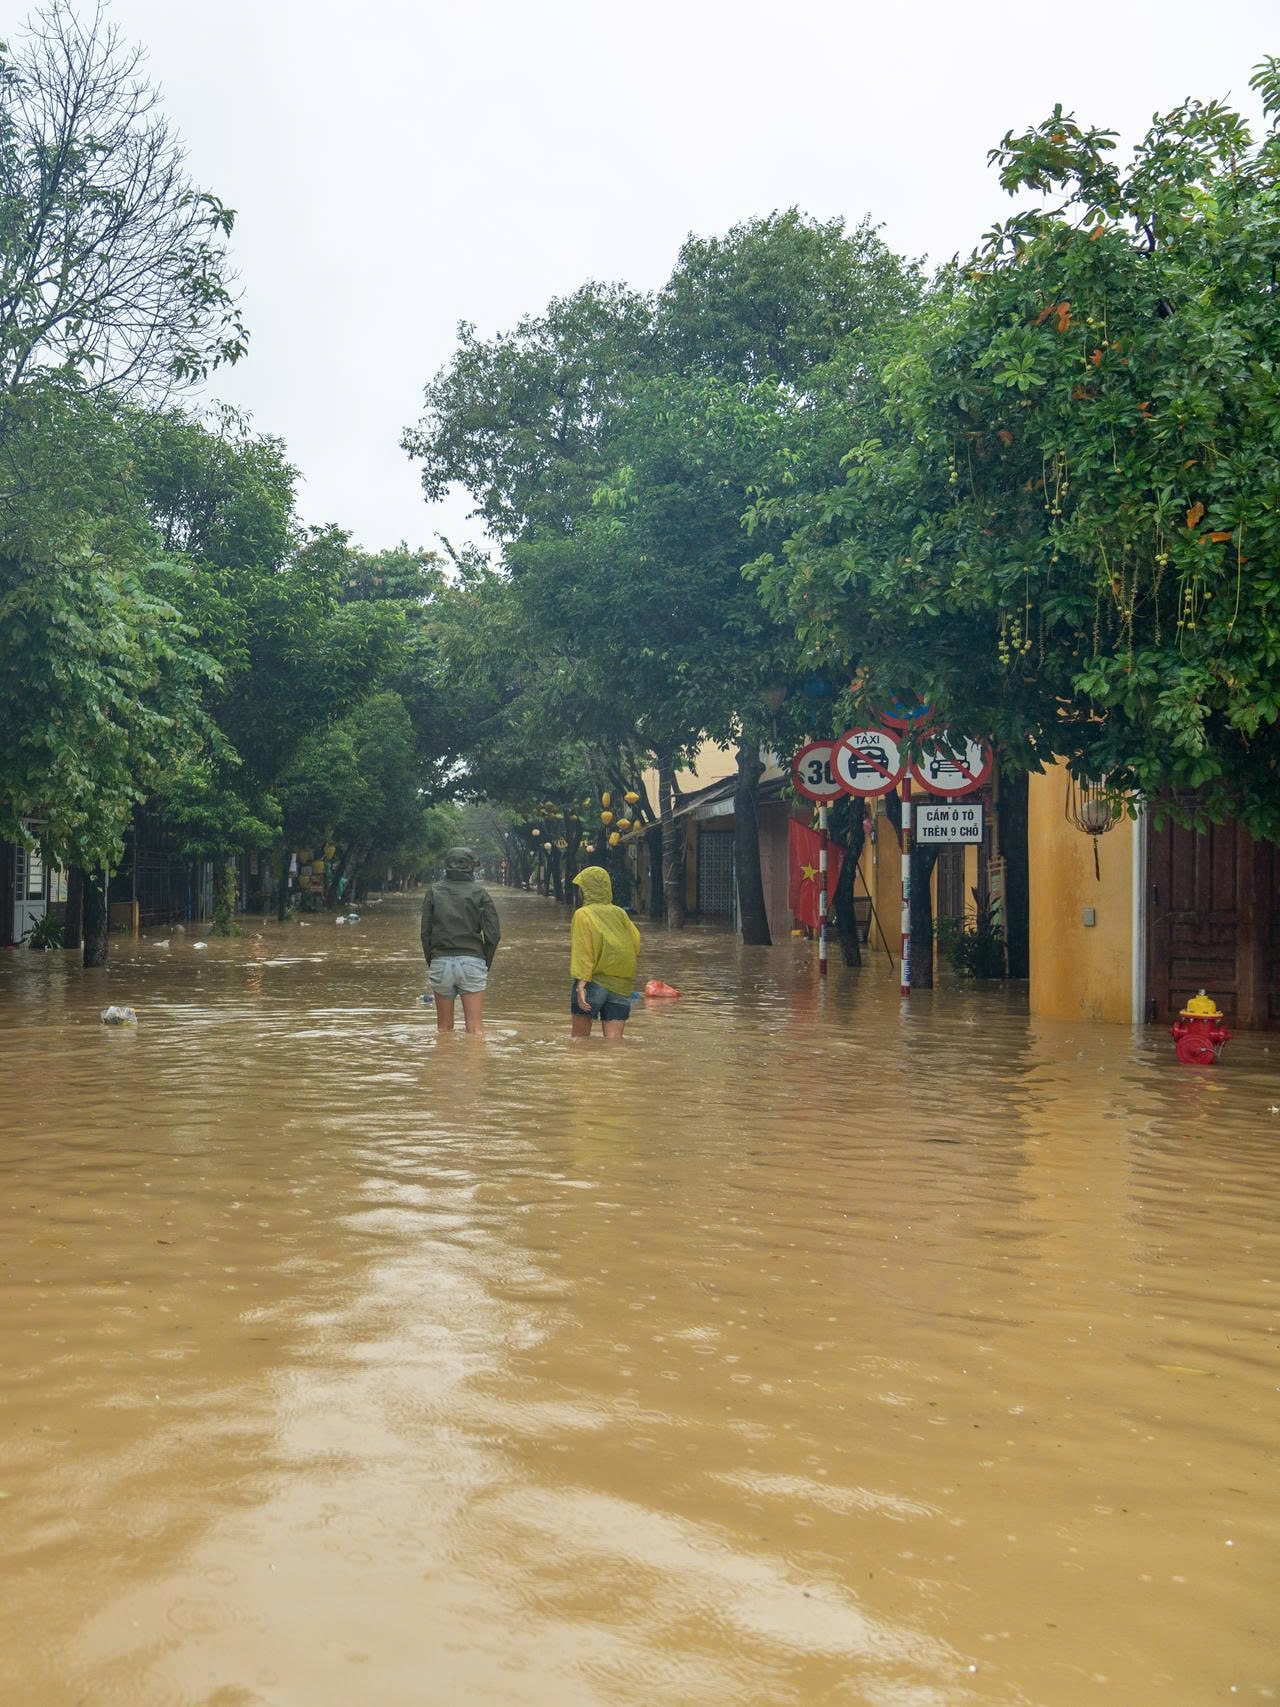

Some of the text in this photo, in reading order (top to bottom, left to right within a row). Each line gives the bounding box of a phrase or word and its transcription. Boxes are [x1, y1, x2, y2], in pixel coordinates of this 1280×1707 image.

[854, 735, 880, 745] TAXI
[926, 808, 974, 821] CẤM Ô TÔ
[922, 825, 948, 837] TRÊN
[950, 827, 957, 837] 9
